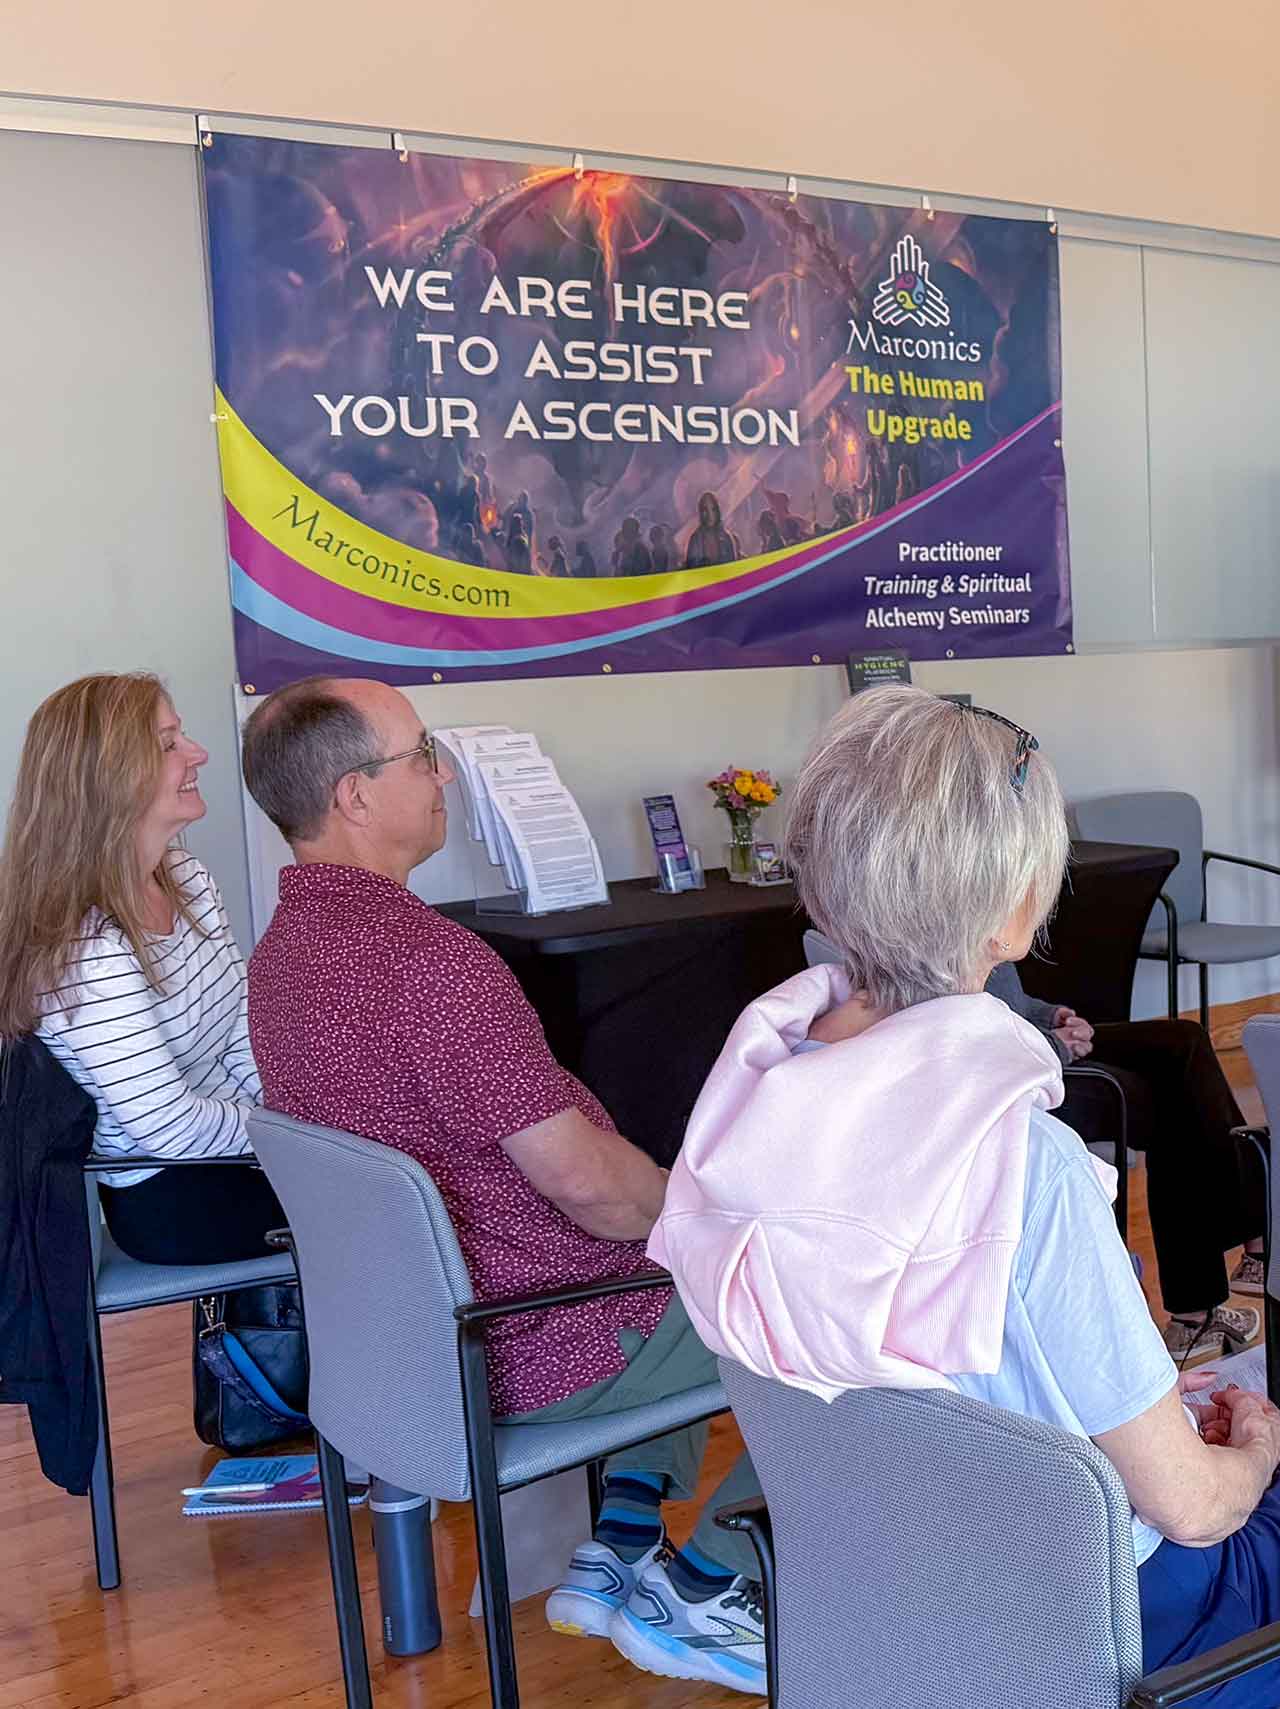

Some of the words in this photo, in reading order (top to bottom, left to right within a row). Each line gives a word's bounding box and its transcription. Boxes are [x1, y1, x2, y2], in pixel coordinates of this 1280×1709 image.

[364, 266, 455, 311] WE
[480, 275, 593, 319] ARE
[613, 283, 752, 329] HERE
[416, 333, 499, 375] TO
[524, 340, 712, 384] ASSIST
[846, 320, 981, 362] Marconics
[845, 366, 894, 394] The
[899, 370, 984, 401] Human
[313, 394, 480, 439] YOUR
[504, 400, 800, 447] ASCENSION
[867, 409, 972, 444] Upgrade
[272, 494, 511, 607] Marconics.com
[899, 541, 1002, 562] Practitioner
[864, 575, 938, 599] Training
[941, 575, 954, 593] &
[958, 573, 1032, 597] Spiritual
[865, 607, 945, 630] Alchemy
[949, 605, 1030, 625] Seminars
